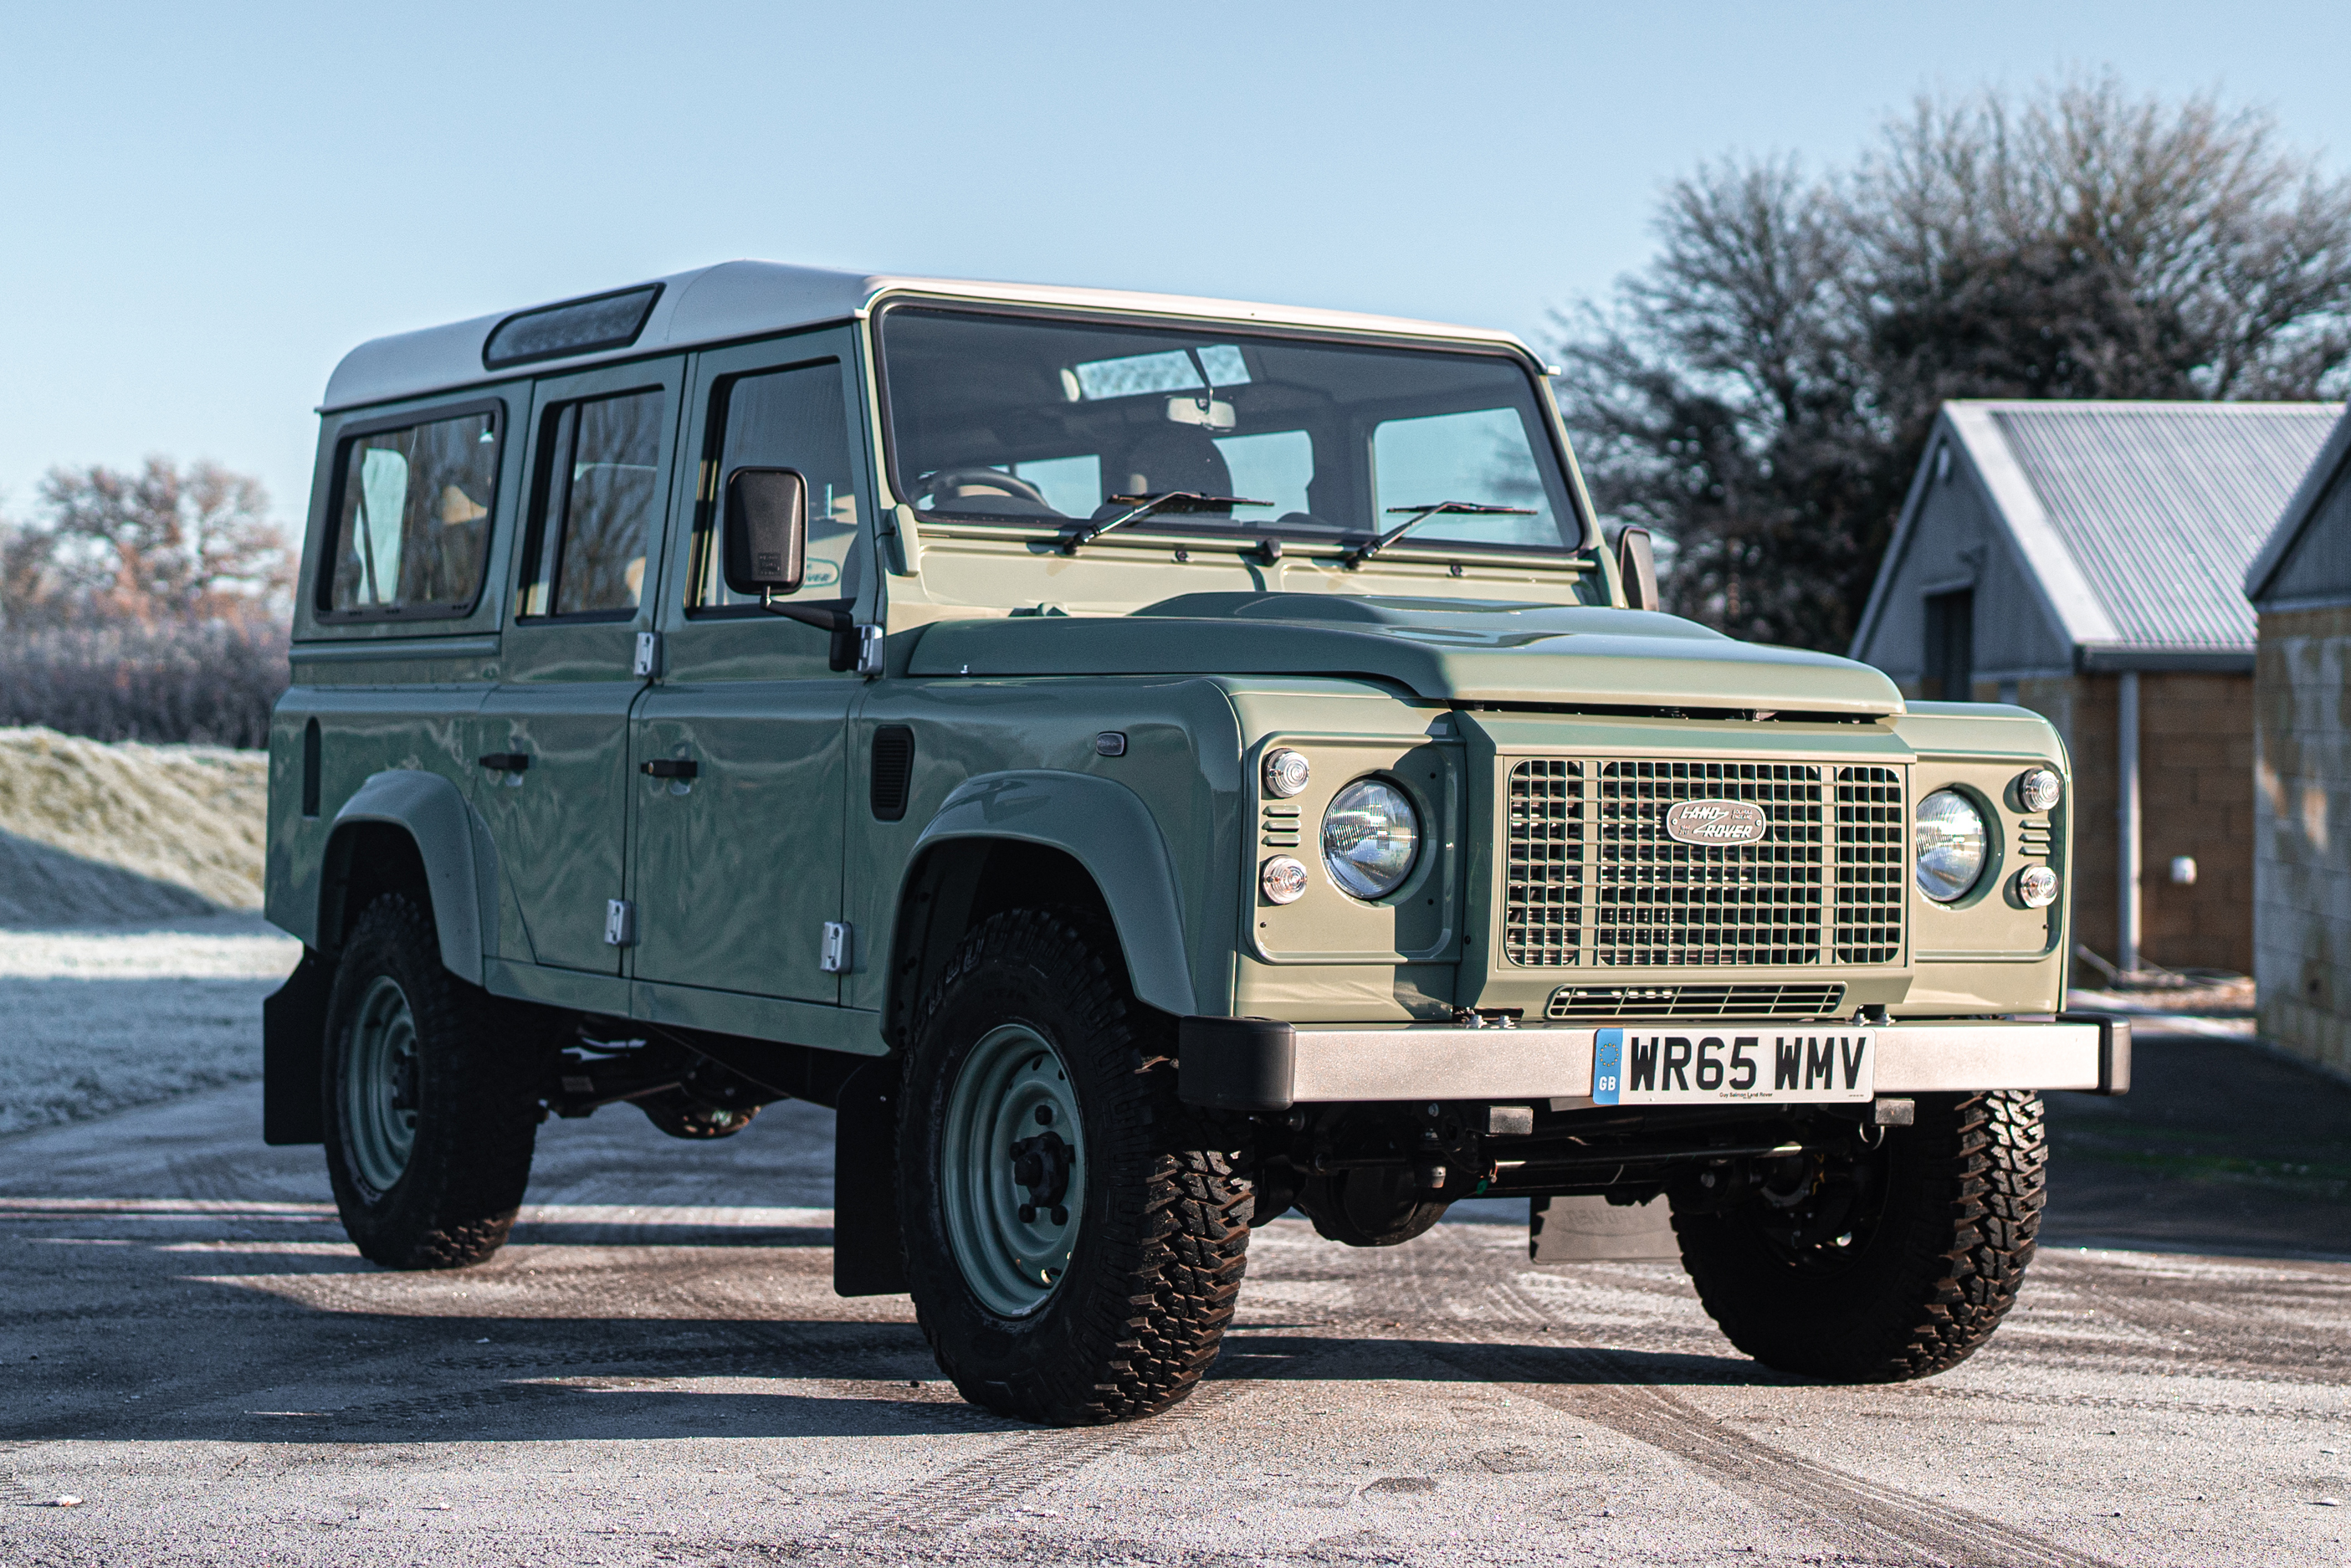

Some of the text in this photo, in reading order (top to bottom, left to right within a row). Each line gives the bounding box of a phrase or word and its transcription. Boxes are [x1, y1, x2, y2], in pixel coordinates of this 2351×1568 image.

[1680, 807, 1724, 819] LAND
[1701, 824, 1753, 838] ROVER
[1629, 1036, 1867, 1091] WR65 WMV
[1599, 1076, 1616, 1091] GB
